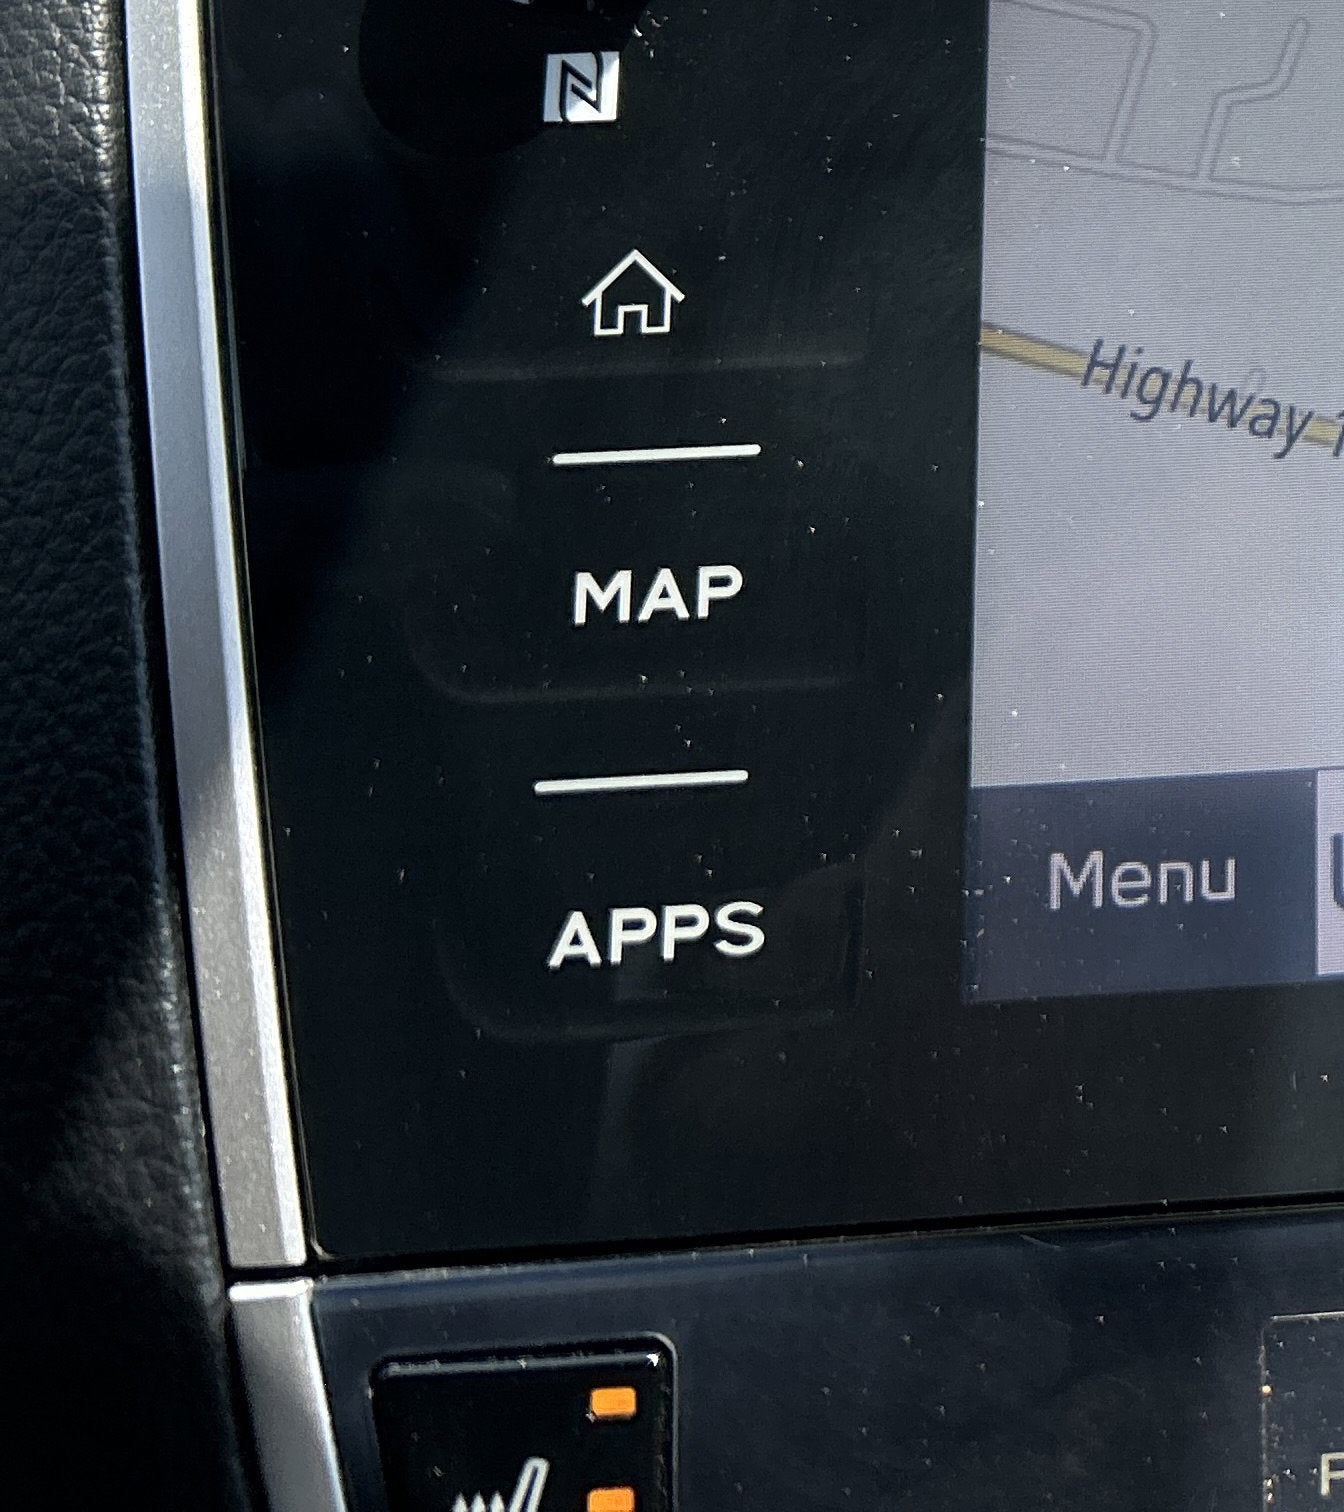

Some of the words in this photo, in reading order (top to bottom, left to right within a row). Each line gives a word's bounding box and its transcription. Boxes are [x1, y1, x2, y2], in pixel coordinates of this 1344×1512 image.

[1080, 338, 1314, 460] Highway
[572, 564, 745, 626] MAP
[1048, 848, 1239, 912] Menu
[548, 900, 767, 969] APPS
